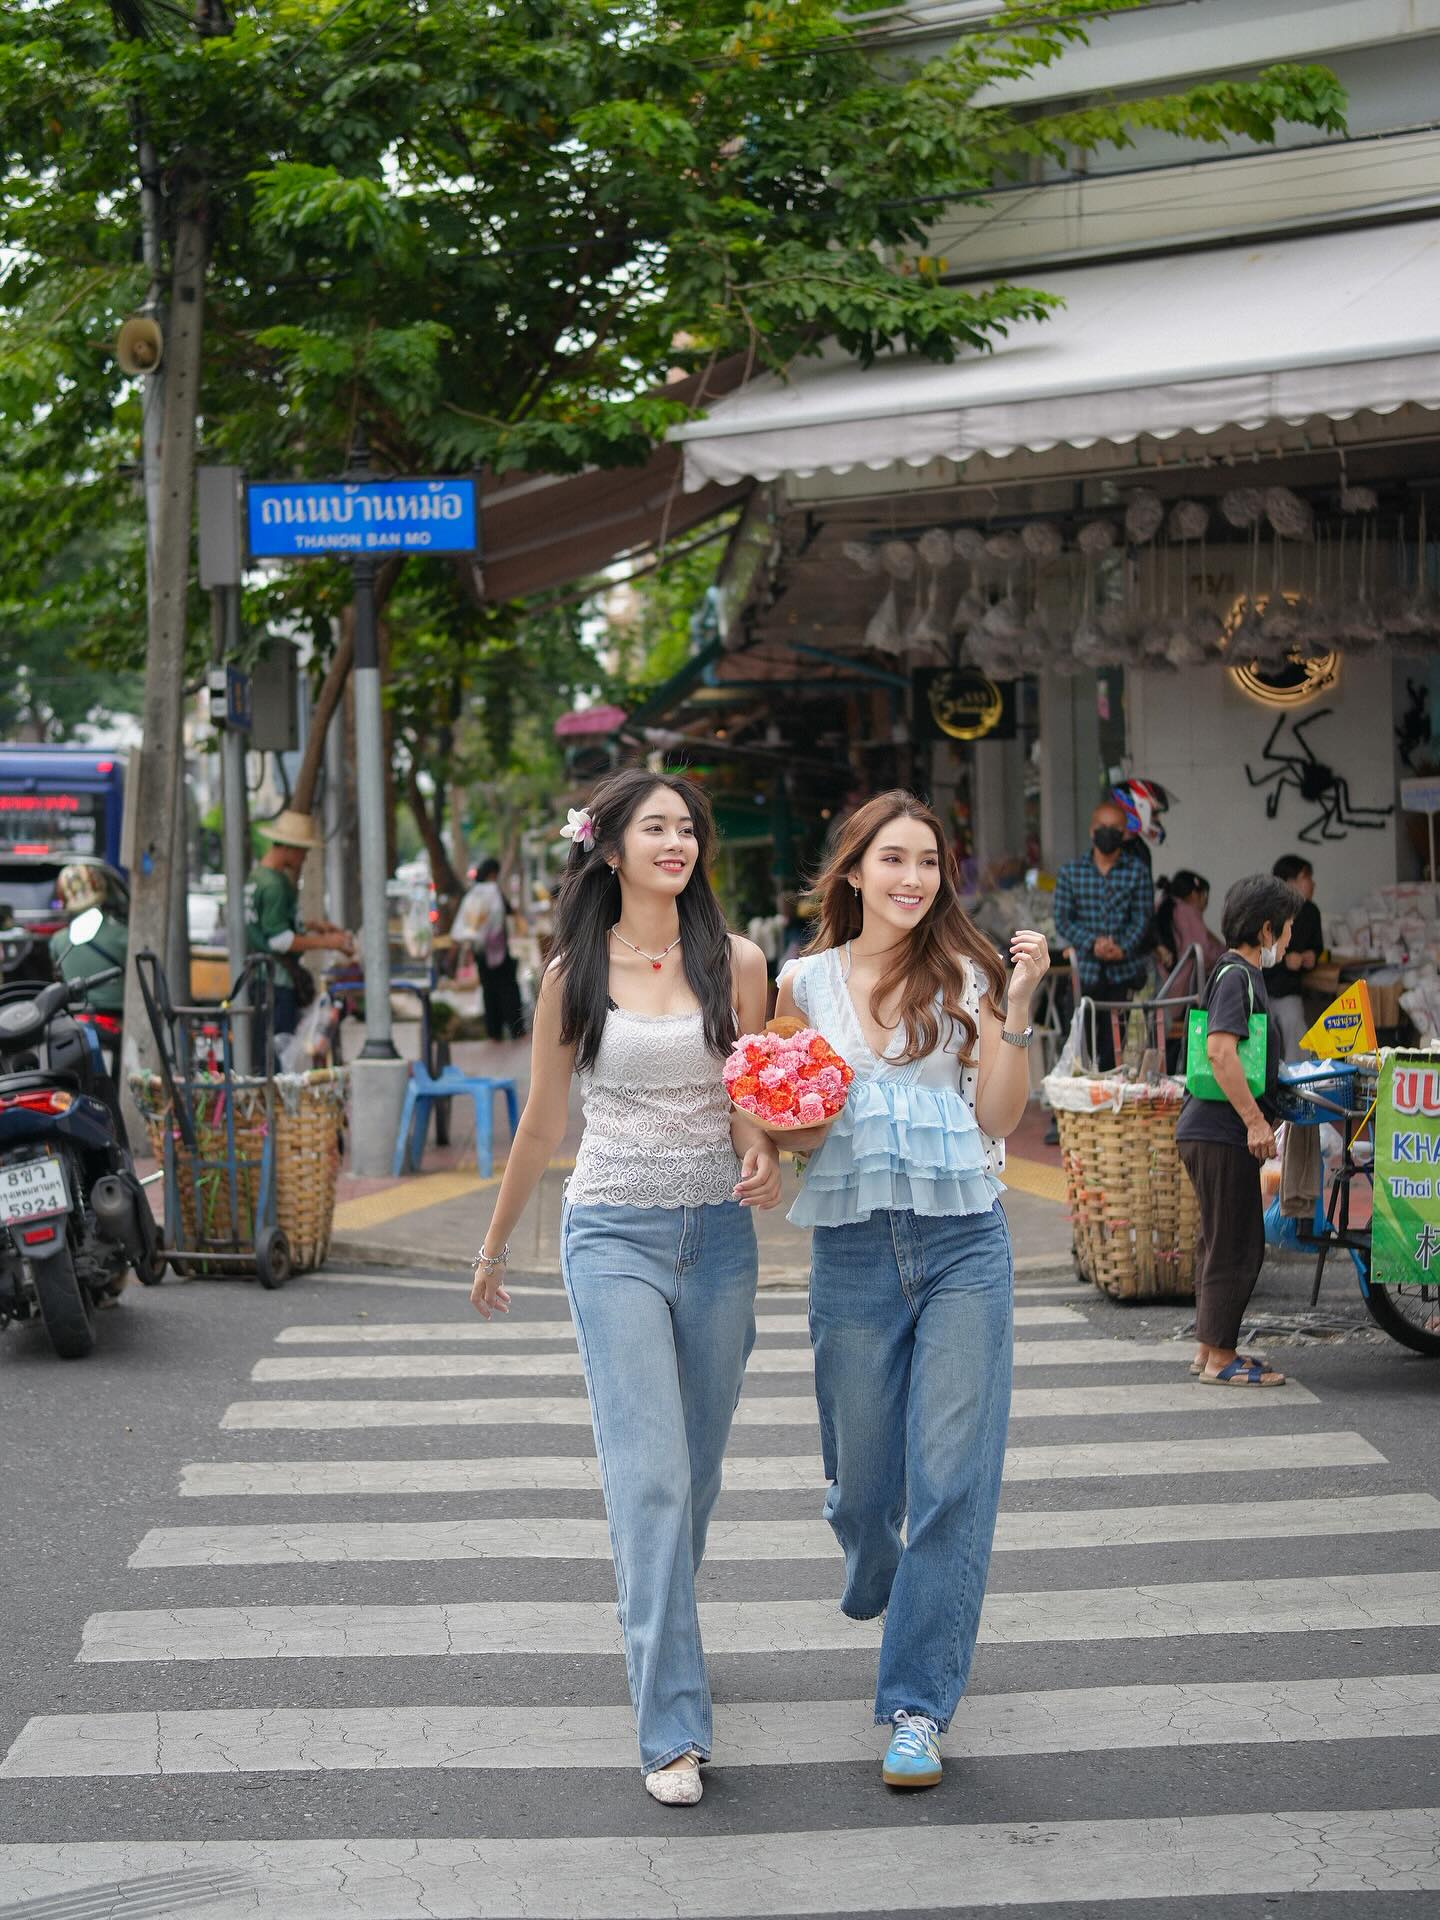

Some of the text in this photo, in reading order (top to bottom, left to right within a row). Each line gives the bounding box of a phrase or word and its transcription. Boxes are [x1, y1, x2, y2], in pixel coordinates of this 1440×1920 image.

[262, 482, 462, 524] ถนนบ้านหม้อ
[295, 531, 431, 548] THANON BAN MO
[1390, 1177, 1431, 1198] Thai
[9, 1195, 58, 1217] 5924
